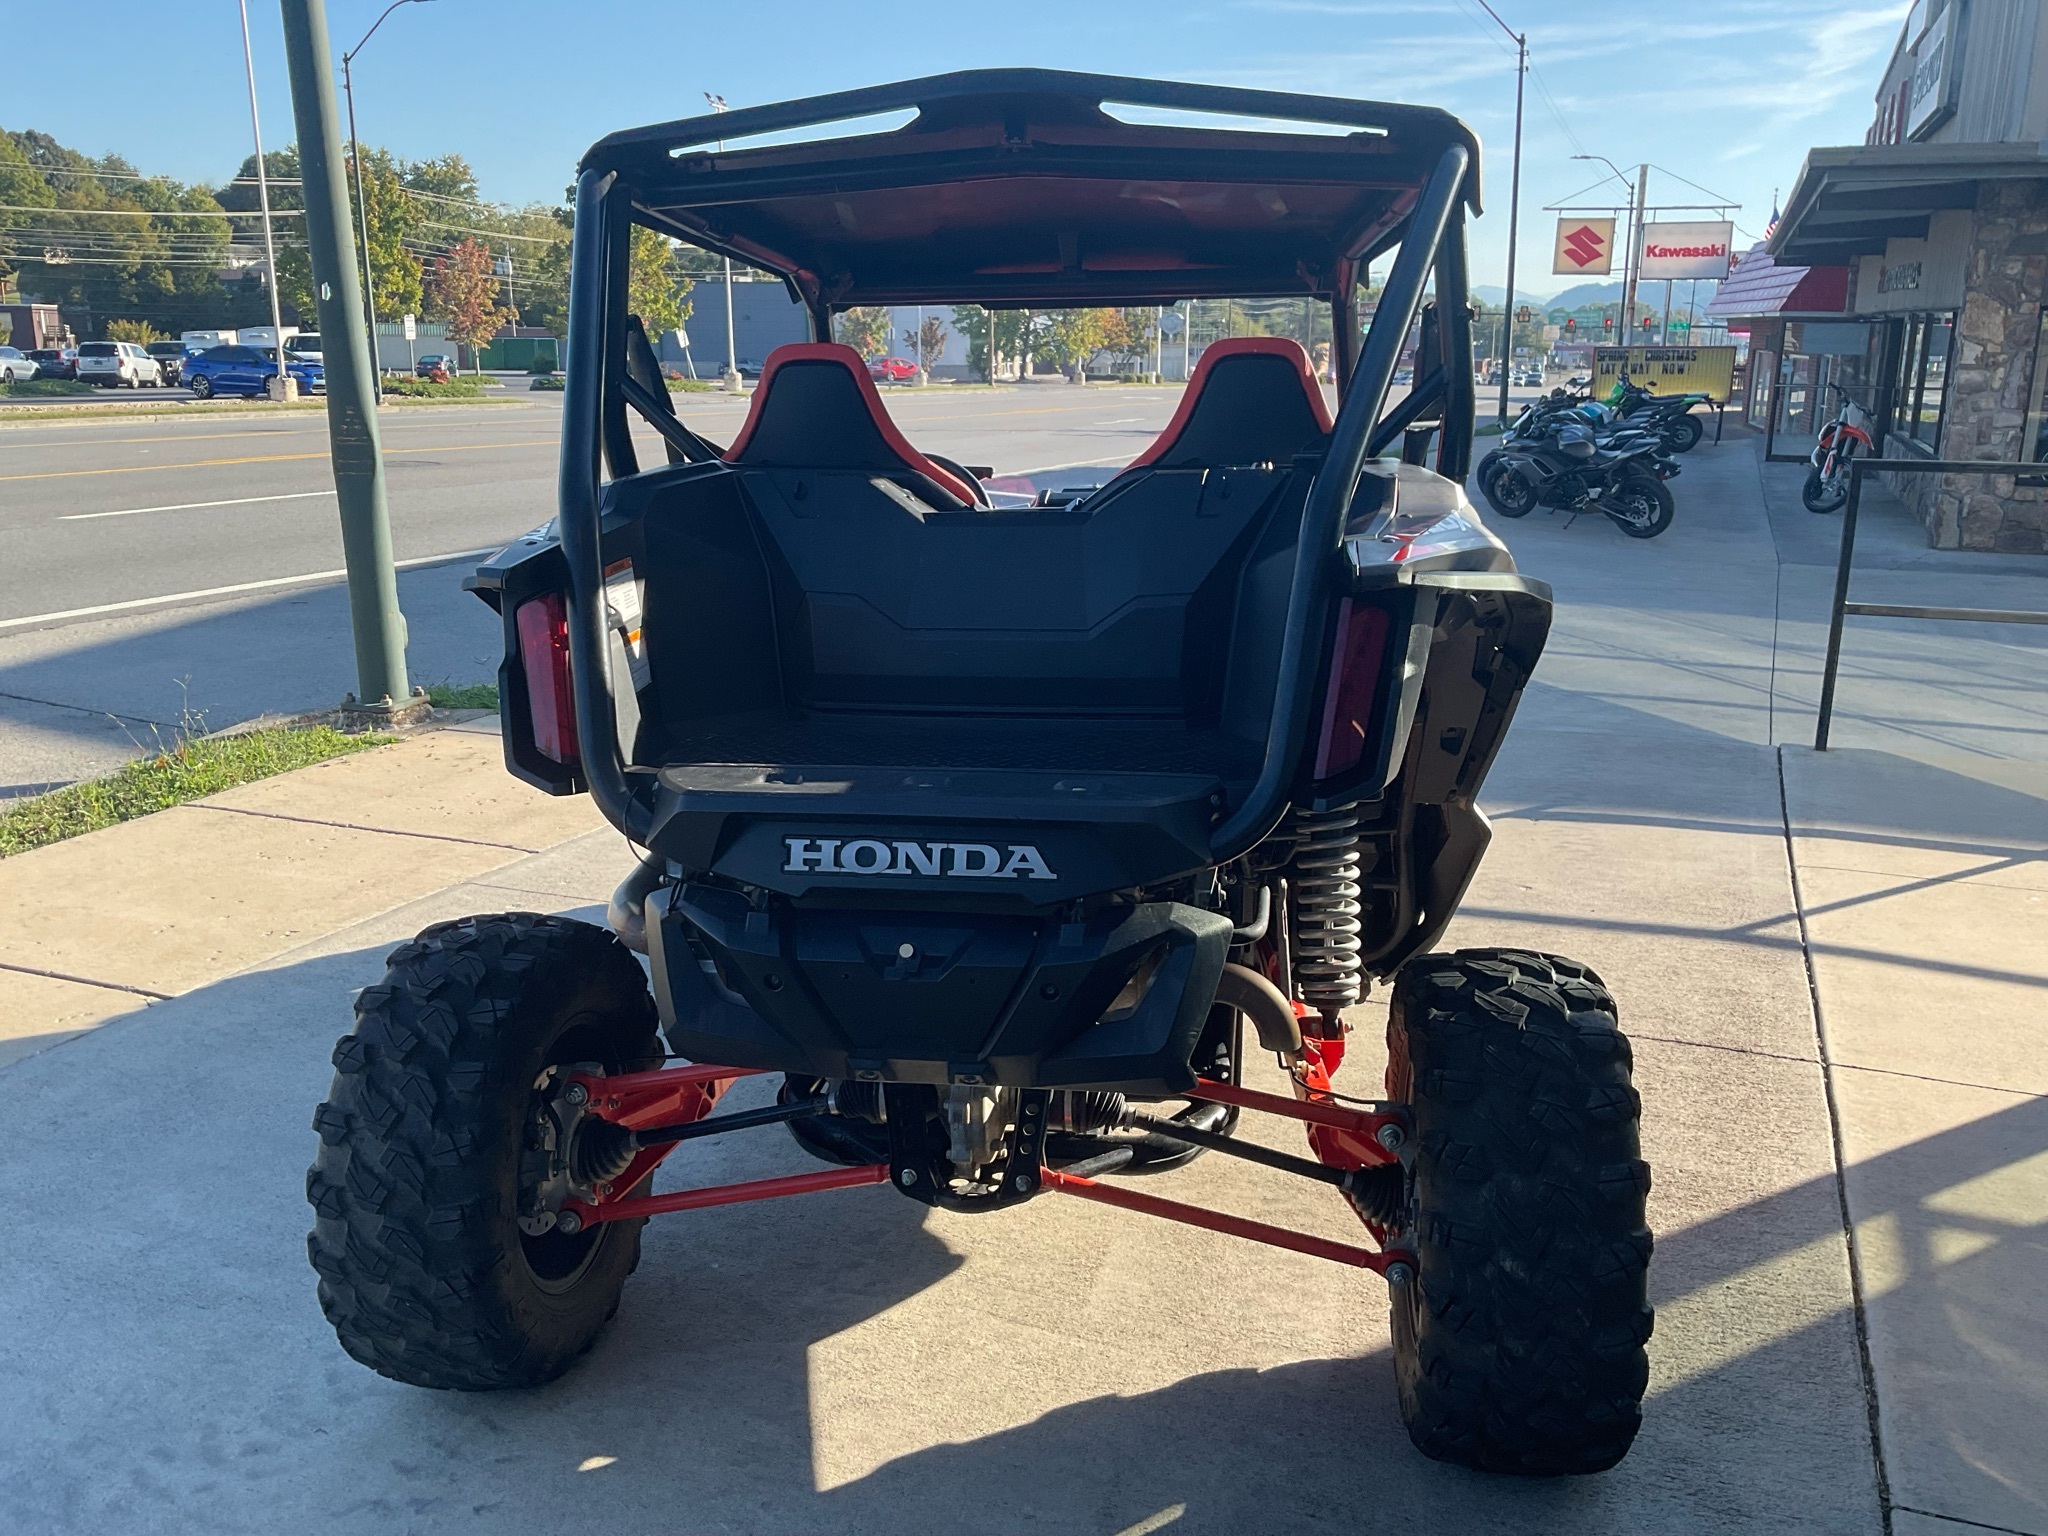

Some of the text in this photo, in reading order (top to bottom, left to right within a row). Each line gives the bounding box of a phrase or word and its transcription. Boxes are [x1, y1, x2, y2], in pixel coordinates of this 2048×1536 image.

[1646, 244, 1726, 258] Kawasaki
[1597, 350, 1629, 361] SPRING
[1645, 350, 1697, 361] CHRISTMAS
[1600, 363, 1616, 375] LAY
[784, 838, 1058, 880] HONDA
